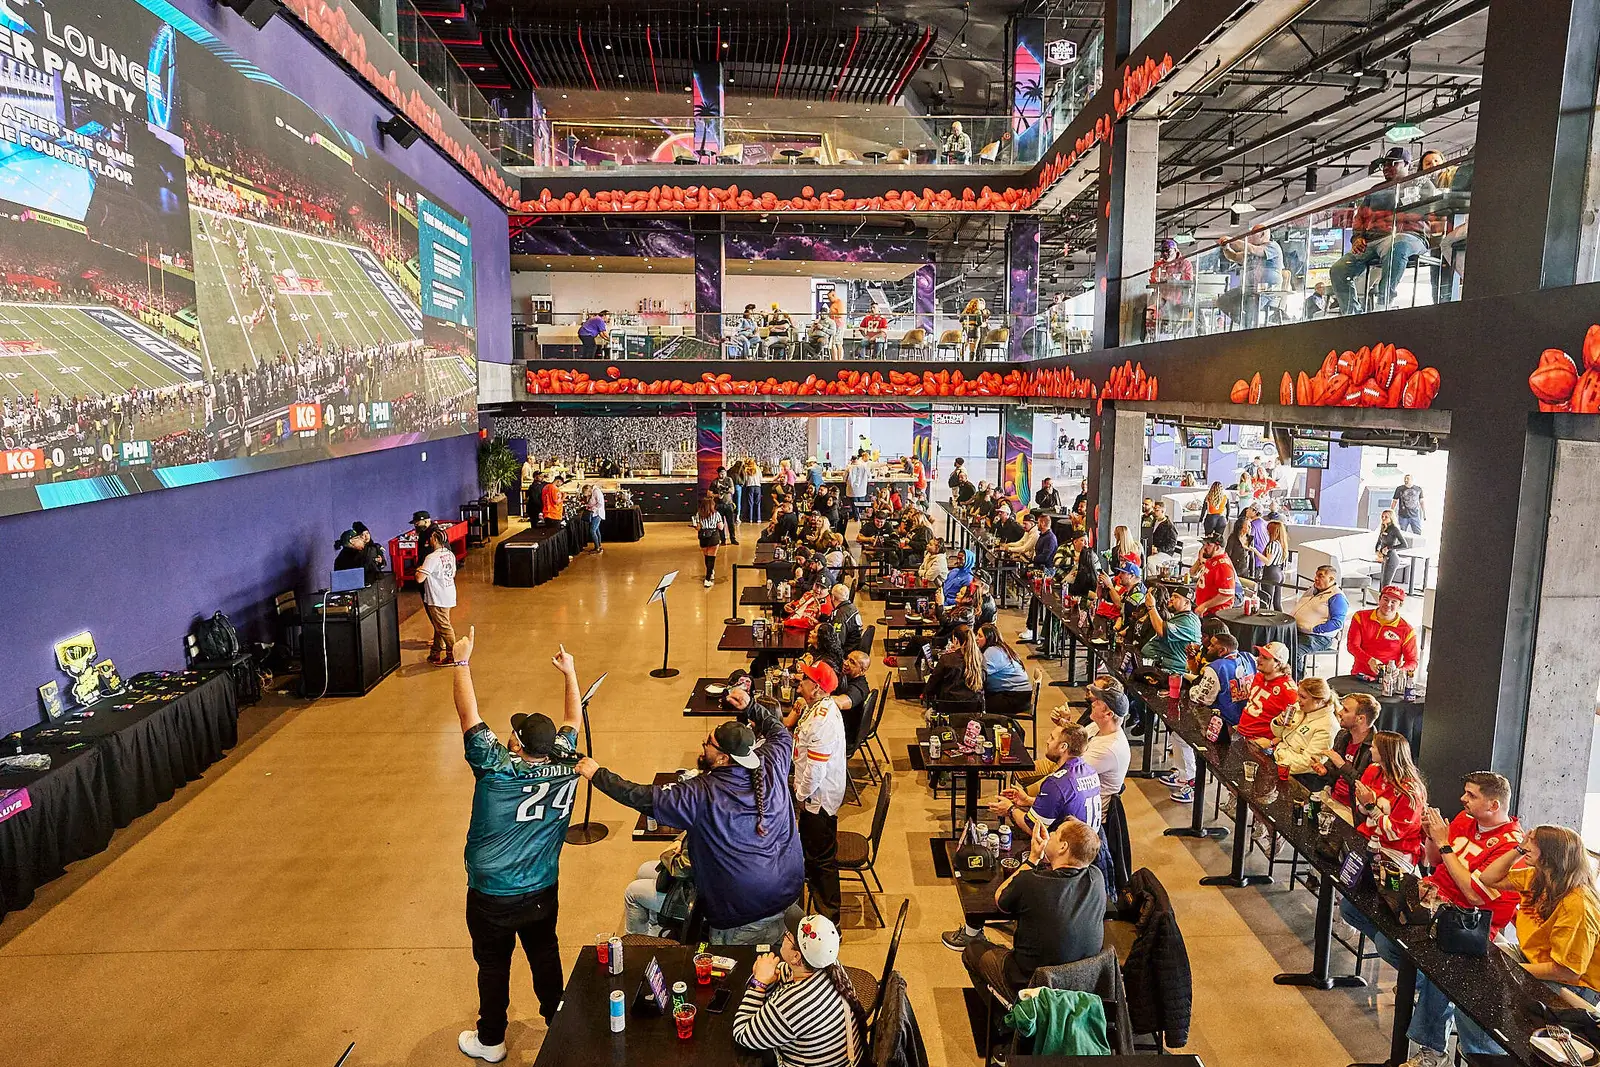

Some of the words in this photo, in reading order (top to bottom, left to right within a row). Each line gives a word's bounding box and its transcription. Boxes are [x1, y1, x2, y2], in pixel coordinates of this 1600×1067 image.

[42, 47, 136, 114] PARTY
[43, 11, 163, 100] LOUNGE
[2, 103, 60, 138] AFTER
[62, 126, 94, 150] THE
[96, 142, 135, 168] GAME
[19, 130, 86, 169] FOURTH
[89, 158, 134, 186] FLOOR
[367, 270, 424, 332] EAGLES
[867, 321, 880, 333] 87
[113, 325, 202, 374] EAGLES
[296, 404, 317, 428] KC
[326, 404, 335, 426] 0
[359, 403, 366, 423] 0
[372, 402, 390, 422] PHI
[6, 451, 35, 471] KC
[52, 448, 65, 467] 0
[73, 446, 94, 457] 15:00
[102, 443, 113, 461] 0
[122, 440, 149, 459] PHI
[516, 778, 579, 822] 24
